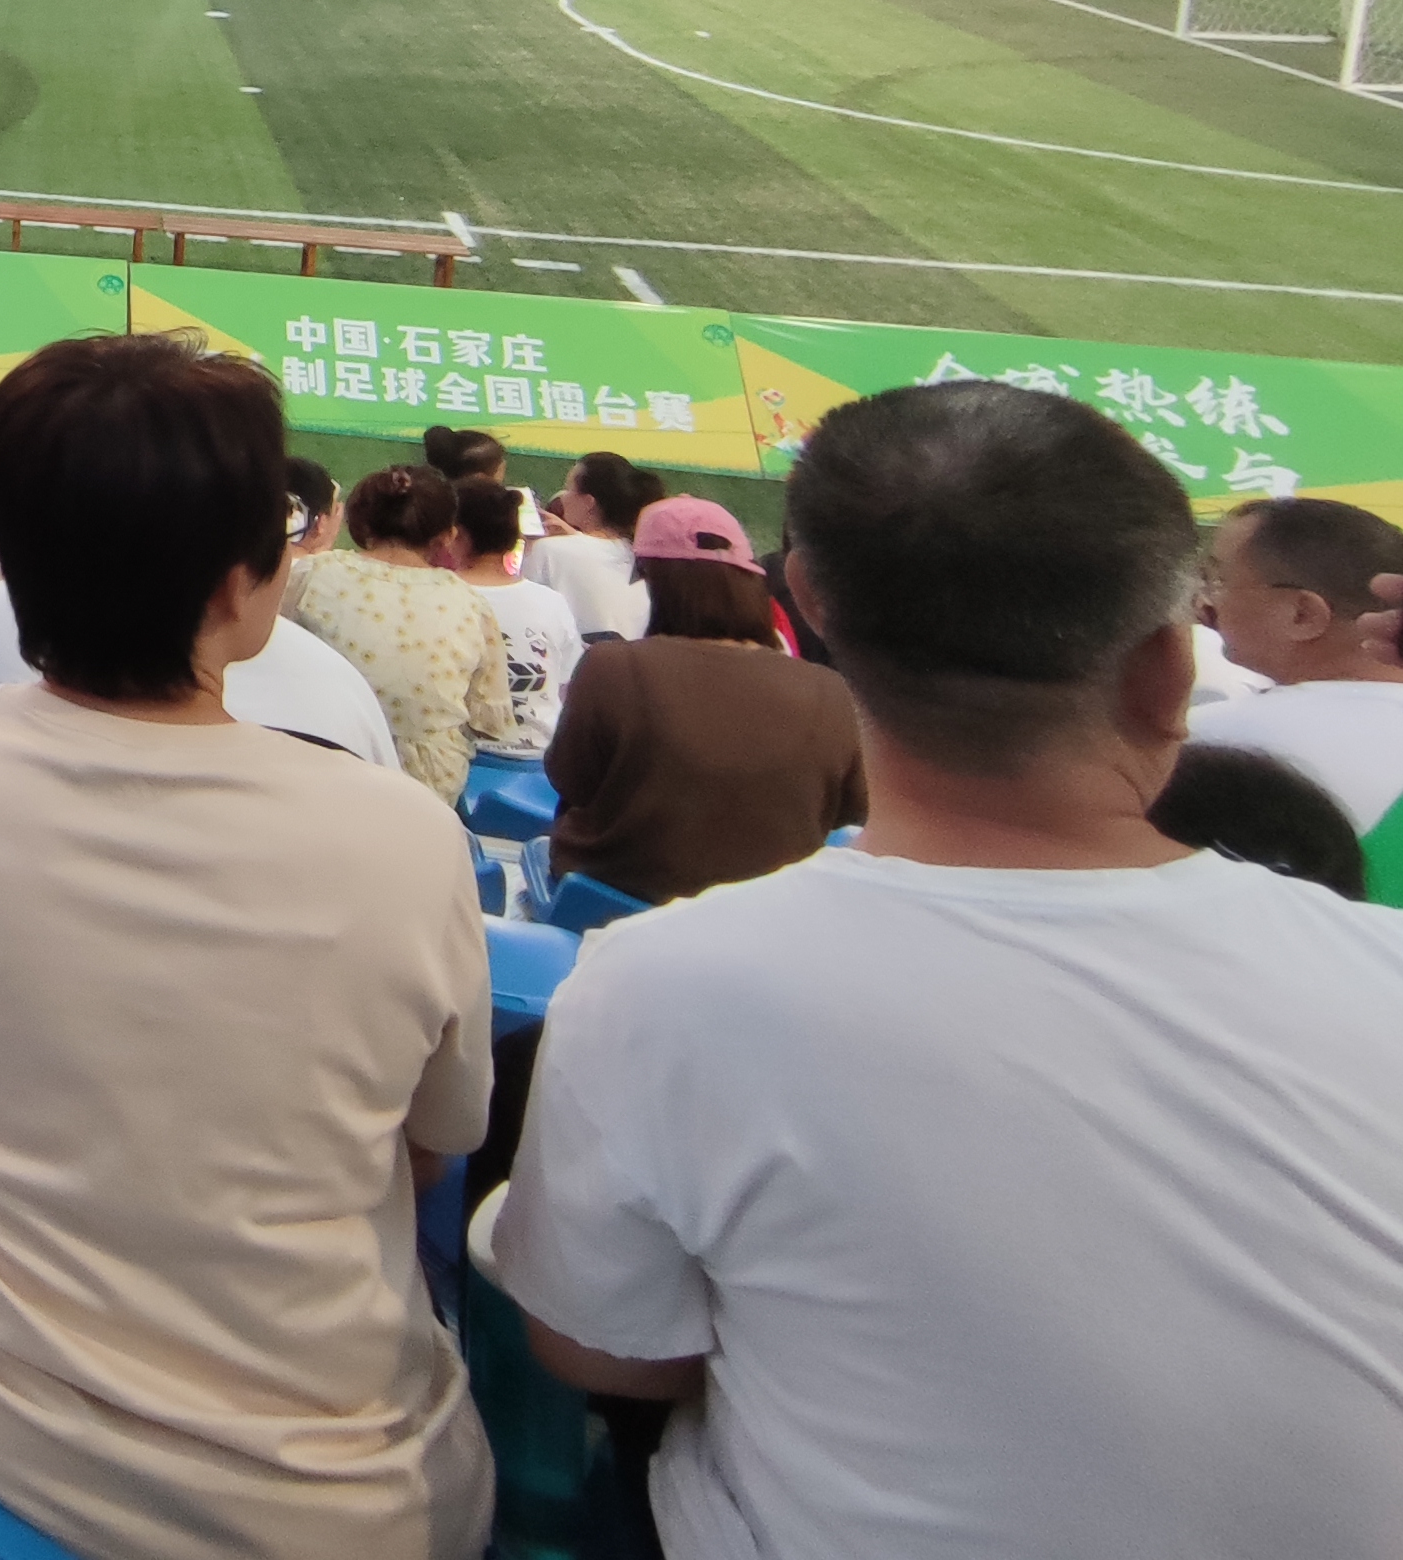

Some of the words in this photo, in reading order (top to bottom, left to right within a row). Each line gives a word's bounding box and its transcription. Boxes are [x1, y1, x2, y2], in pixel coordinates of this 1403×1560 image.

[284, 315, 549, 375] 中国·石家庄
[281, 354, 696, 432] 制足球全国擂台赛
